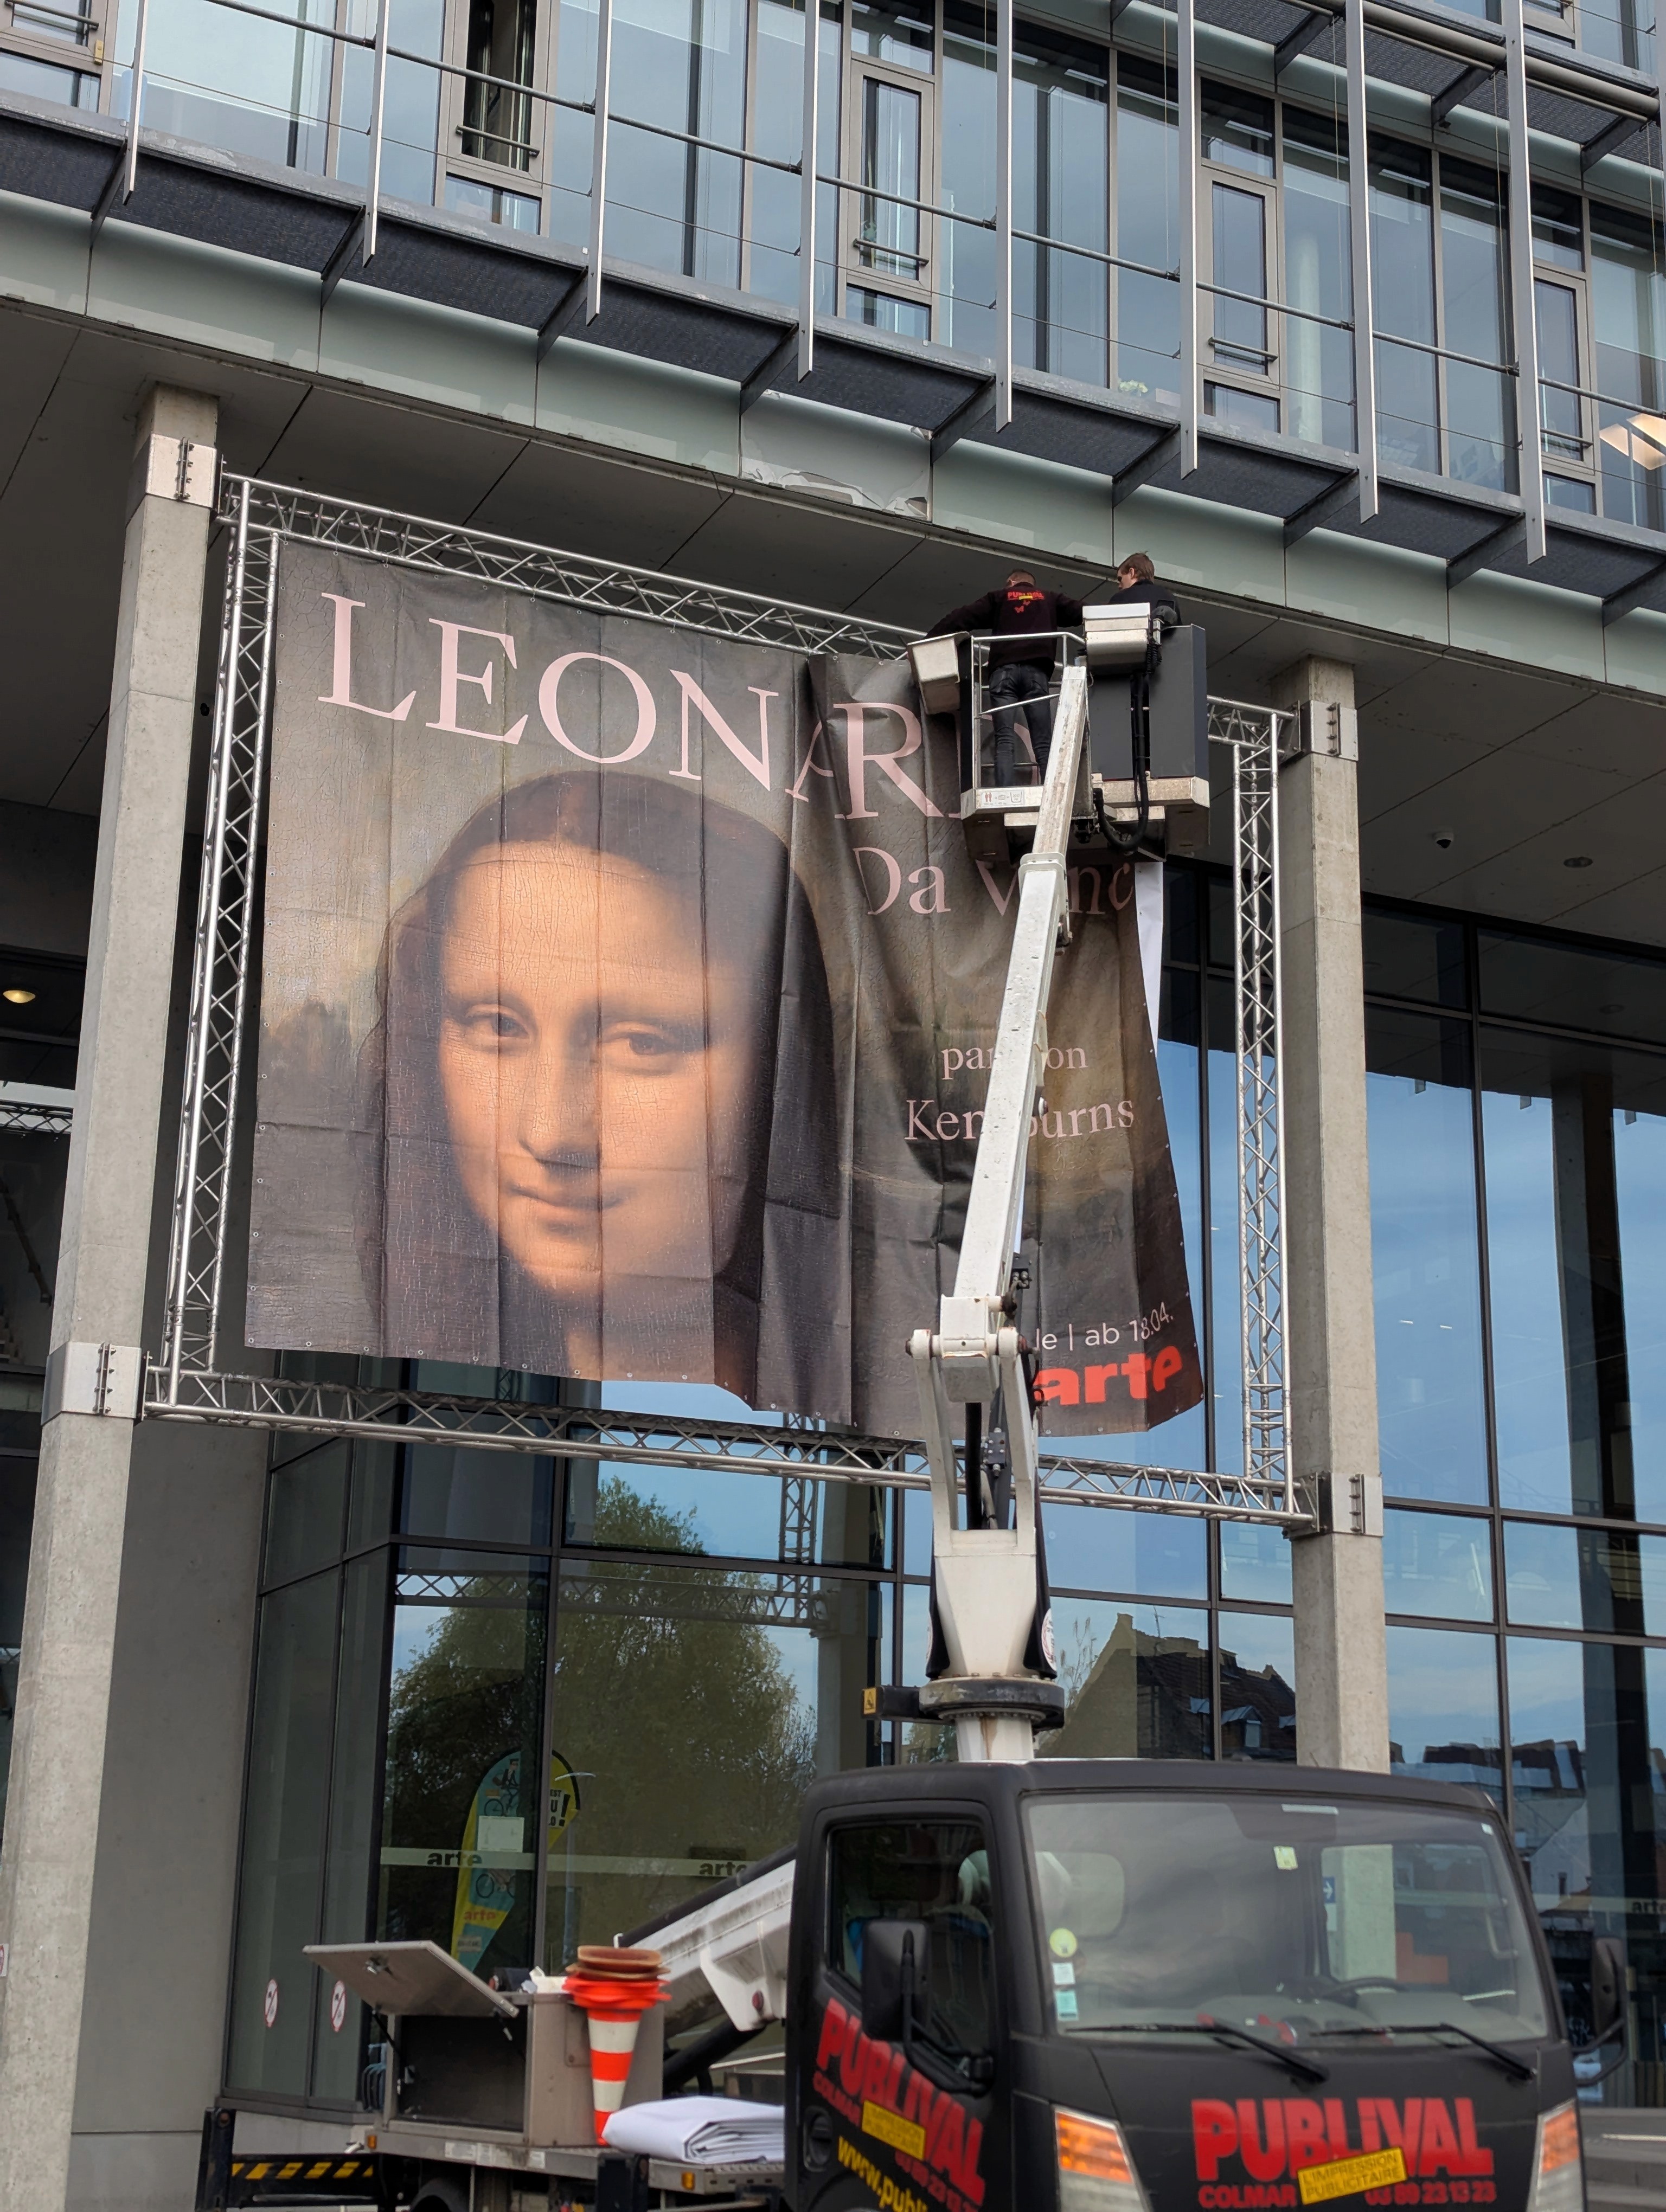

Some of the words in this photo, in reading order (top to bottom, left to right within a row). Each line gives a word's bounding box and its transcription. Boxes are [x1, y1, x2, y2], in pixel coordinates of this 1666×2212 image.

[853, 847, 951, 915] Da
[1085, 1322, 1120, 1346] ab
[1033, 1345, 1182, 1405] arte
[427, 1851, 483, 1866] arte
[1198, 2184, 1297, 2209] COLMAR
